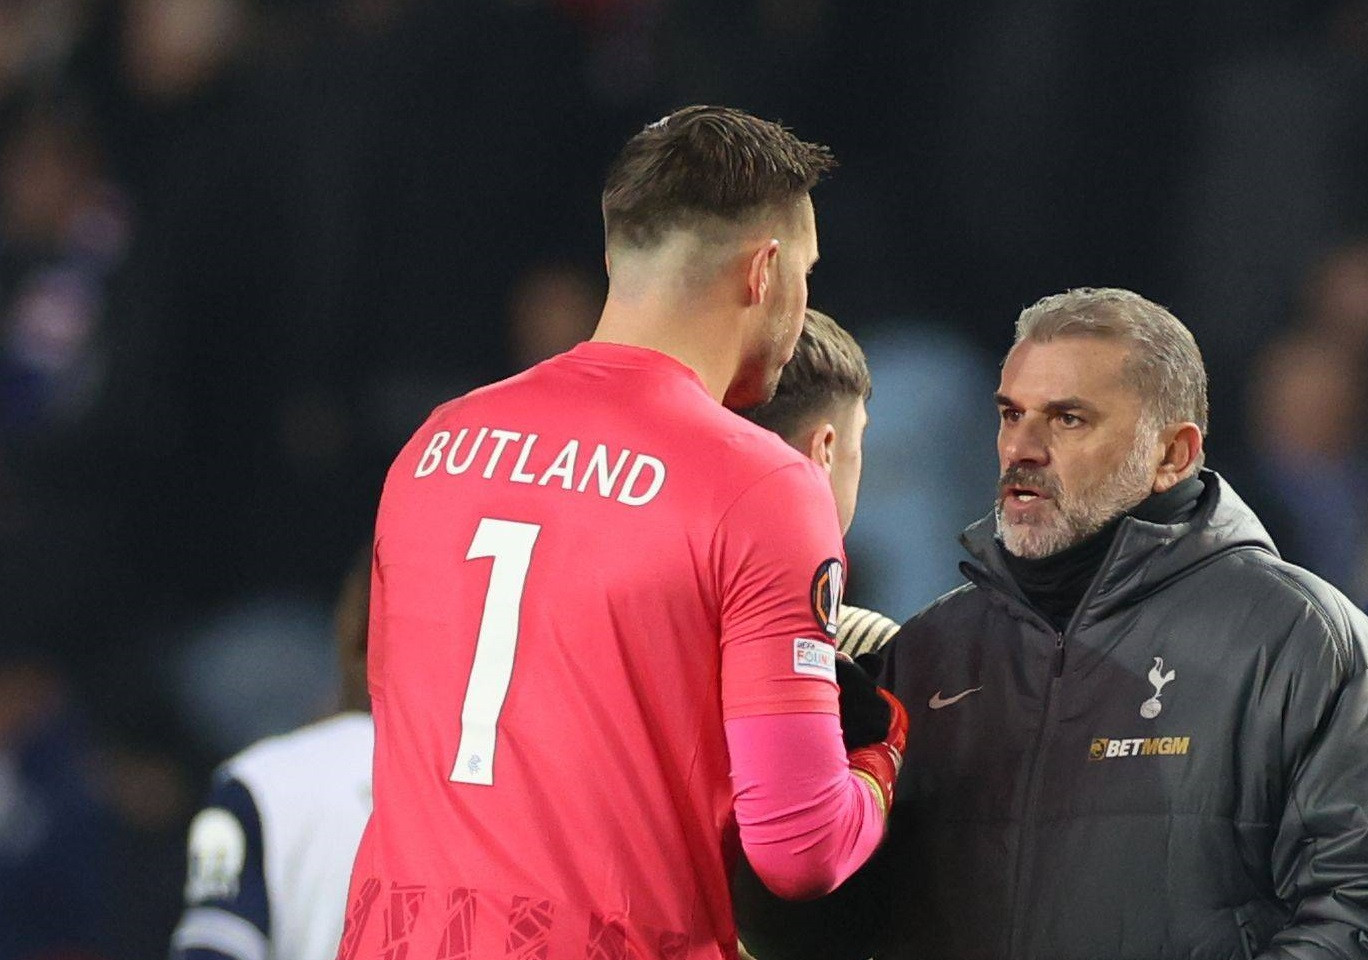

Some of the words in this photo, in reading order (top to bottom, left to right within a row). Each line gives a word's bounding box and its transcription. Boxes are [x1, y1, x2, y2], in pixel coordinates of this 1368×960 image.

[414, 427, 667, 507] BUTLAND
[448, 516, 542, 787] 1
[1105, 737, 1190, 758] BETMGM
